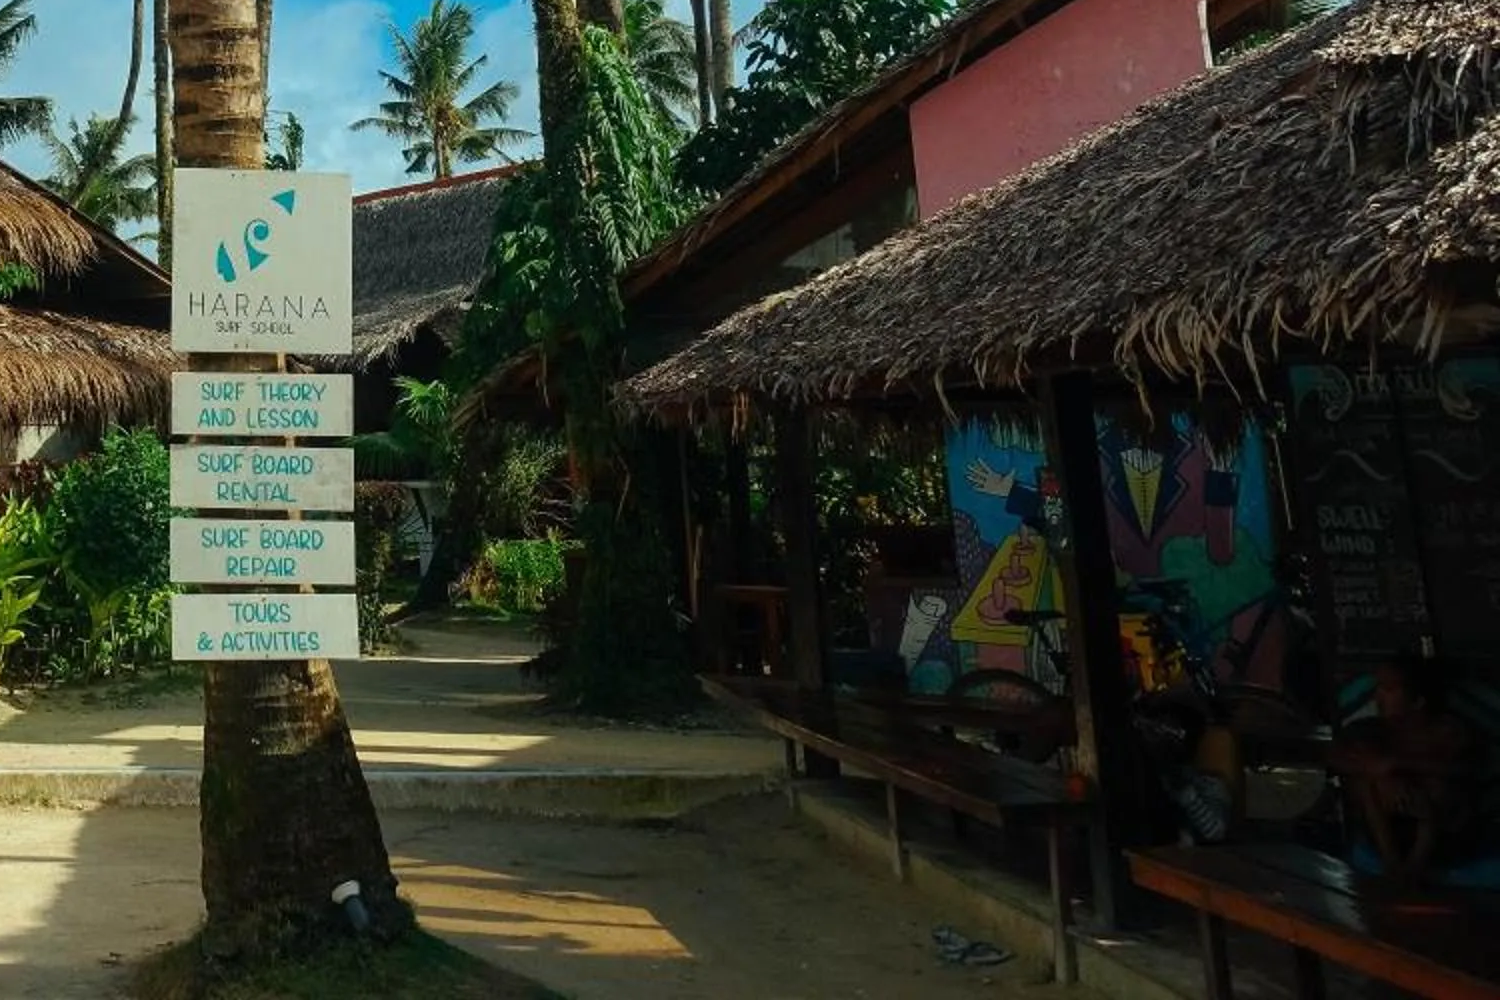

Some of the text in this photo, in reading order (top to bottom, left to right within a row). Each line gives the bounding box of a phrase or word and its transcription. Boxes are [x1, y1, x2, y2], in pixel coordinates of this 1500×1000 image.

[188, 291, 330, 319] HARANA
[216, 321, 295, 335] SURF SCHOOL
[201, 381, 327, 401] SURF THEORY
[198, 408, 319, 428] AND LESSON
[197, 453, 314, 475] SURF BOARD
[217, 481, 297, 502] RENTAL
[201, 527, 325, 550] SURF BOARD
[226, 556, 297, 577] REPAIR
[228, 603, 291, 624] TOURS
[196, 631, 320, 652] & ACTIVITIES
